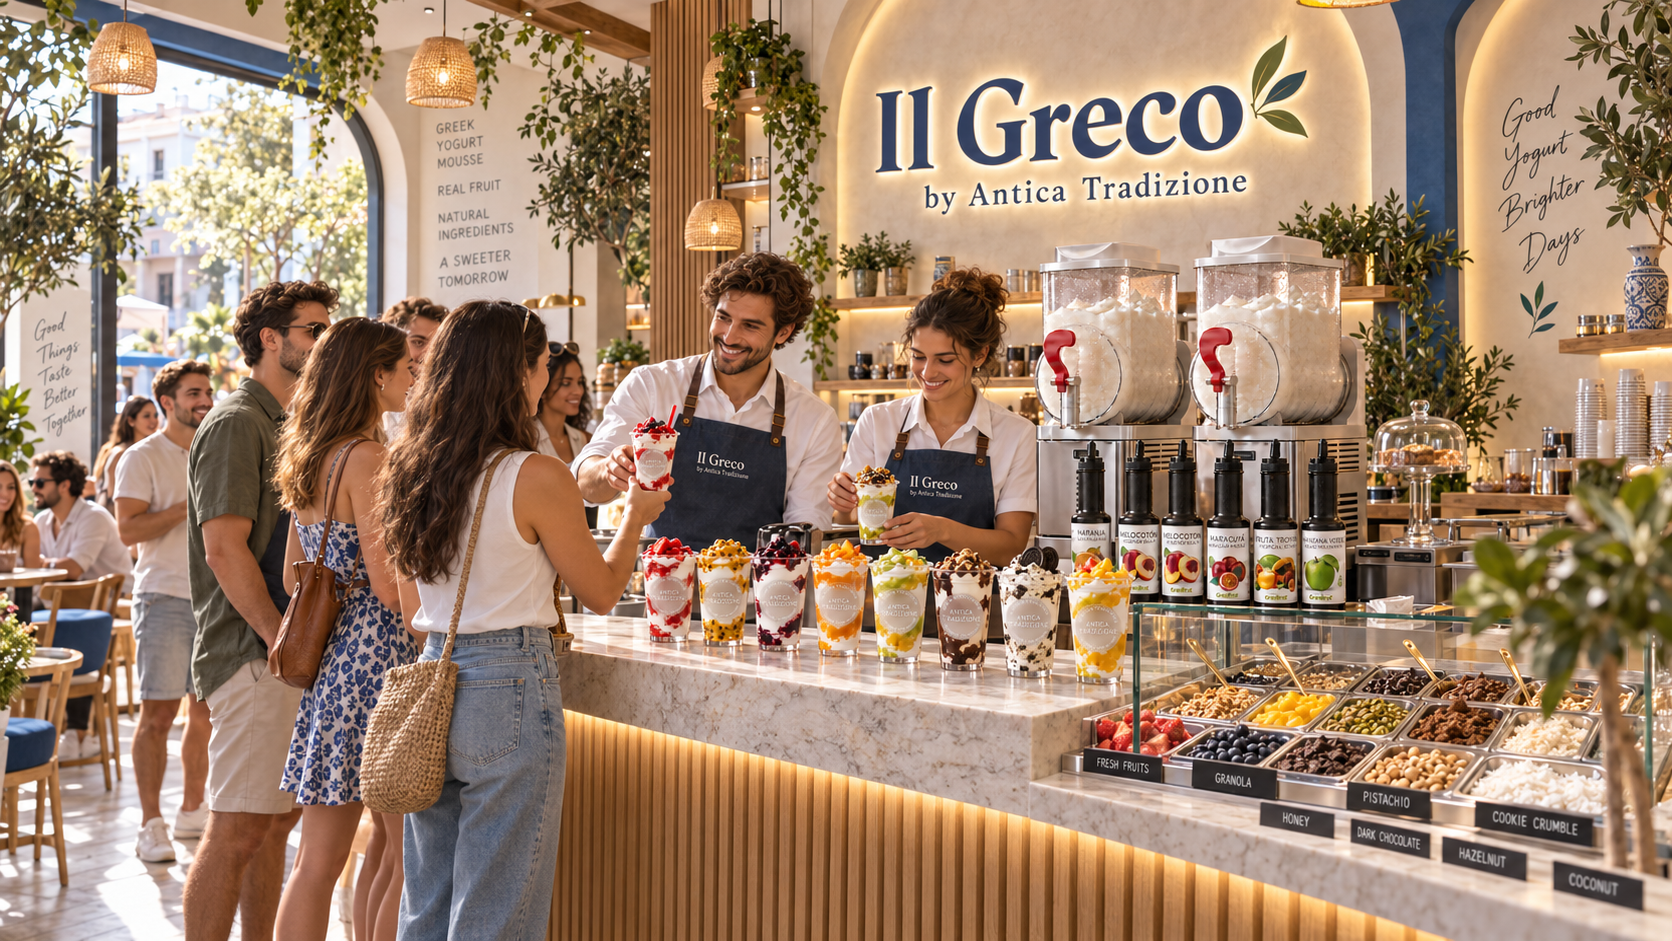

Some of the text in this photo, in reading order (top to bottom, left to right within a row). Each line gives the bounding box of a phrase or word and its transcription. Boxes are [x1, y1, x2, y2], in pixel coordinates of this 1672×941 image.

[1502, 85, 1560, 143] Good
[436, 119, 475, 134] GREEK
[876, 78, 1243, 173] Il Greco
[436, 135, 484, 152] YOGURT
[437, 153, 484, 169] MOUSSE
[1502, 130, 1574, 191] Yogurt
[438, 179, 501, 196] REAL FRUIT
[924, 171, 1247, 215] by Antica Tradizione
[1498, 174, 1585, 233] Brighter
[438, 208, 490, 224] NATURAL
[438, 222, 514, 241] INGREDIENTS
[439, 249, 511, 269] A SWEETER
[1519, 227, 1585, 274] Days
[438, 269, 509, 288] TOMORROW
[34, 311, 67, 341] Good
[36, 341, 80, 364] Things
[37, 364, 72, 386] Taste
[43, 386, 78, 410] Better
[42, 405, 87, 437] Together
[697, 451, 745, 471] Il Greco
[909, 475, 958, 491] Il Greco
[1096, 757, 1150, 774] FRESH FRUITS
[1215, 773, 1252, 788] GRANOLA
[1363, 790, 1411, 809] PISTACHIO
[1282, 812, 1310, 827] HONEY
[1492, 810, 1579, 836] COOKIE CRUMBLE
[1357, 826, 1421, 850] DARK CHOCOLATE
[1459, 847, 1506, 869] HAZELNUT
[1568, 872, 1619, 896] COCONUT
